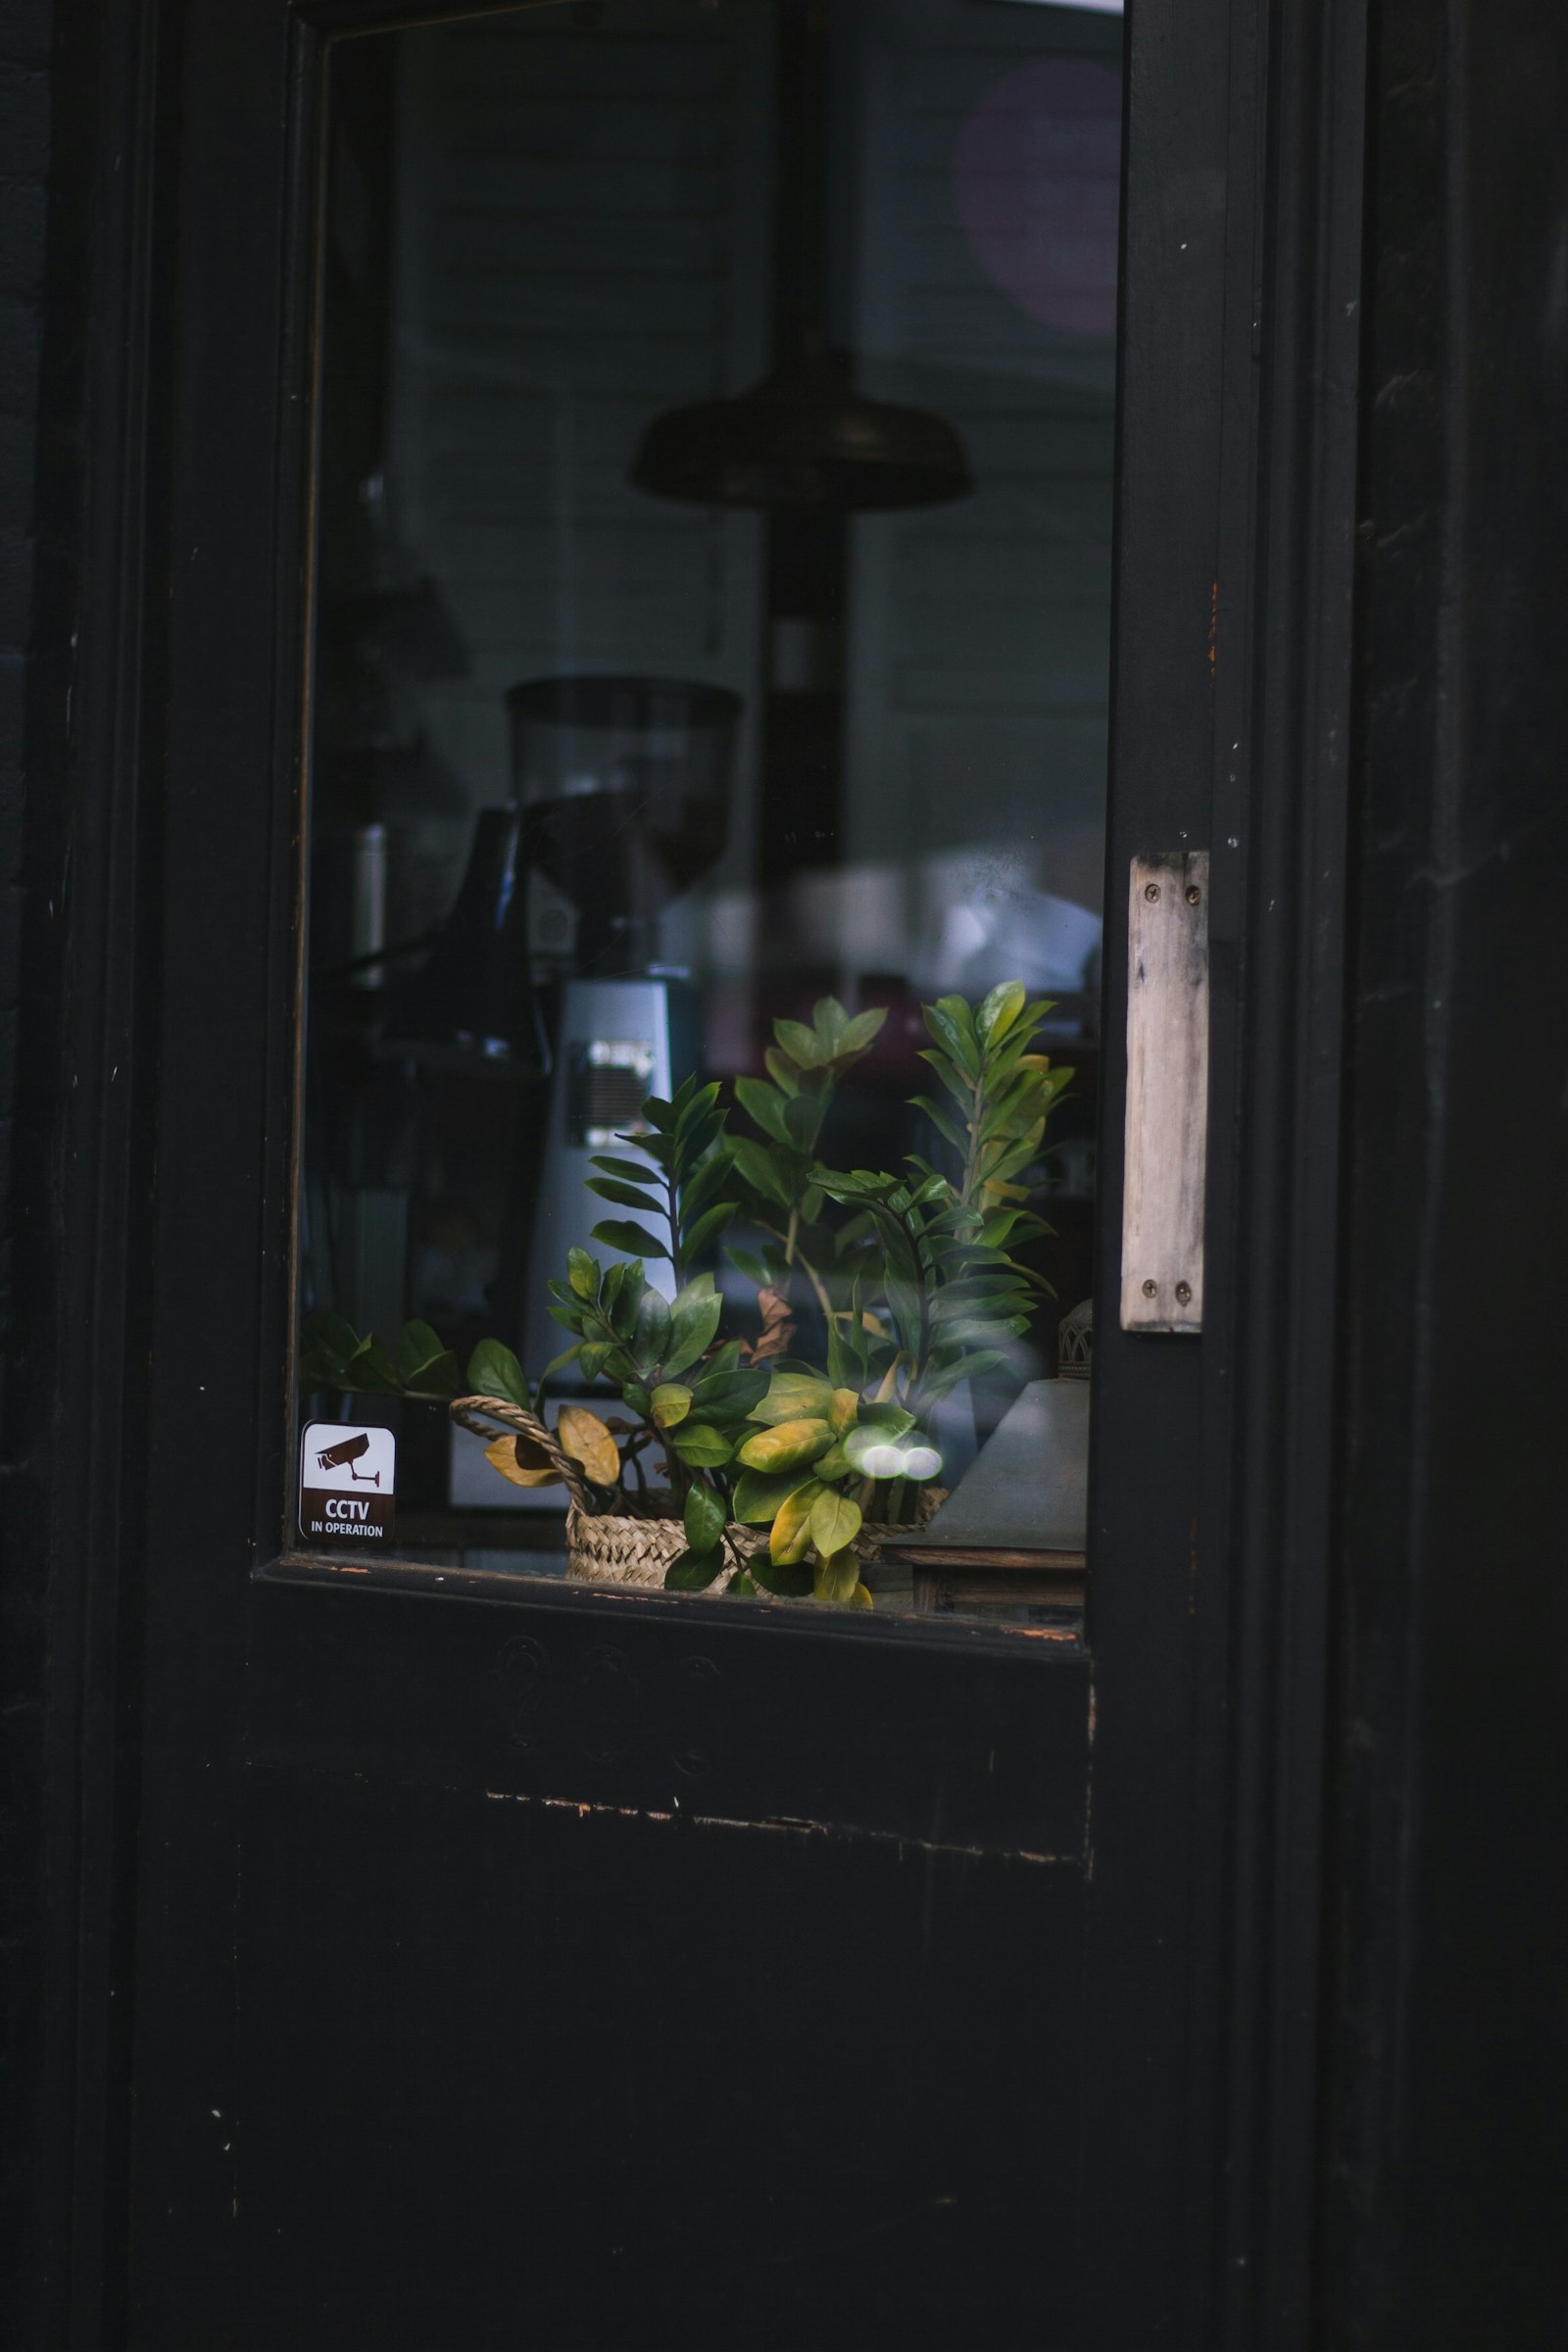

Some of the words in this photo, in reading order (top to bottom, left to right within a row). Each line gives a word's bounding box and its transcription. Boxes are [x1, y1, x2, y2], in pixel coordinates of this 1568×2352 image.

[325, 1498, 369, 1520] CCTV
[312, 1521, 322, 1532] IN
[325, 1522, 383, 1537] OPERATION
